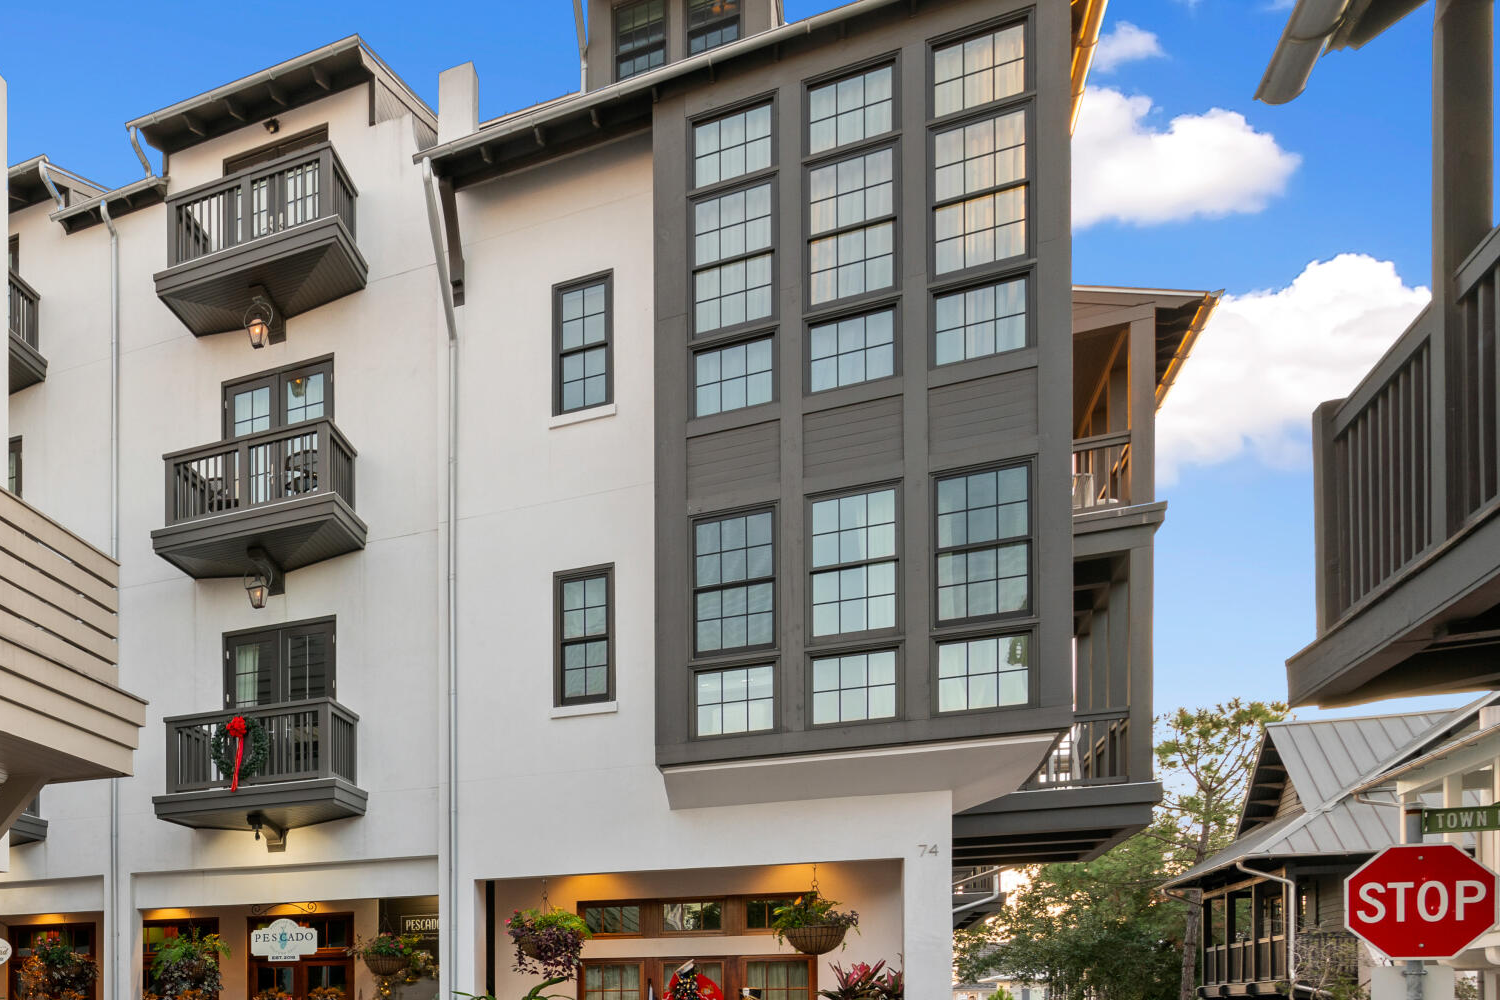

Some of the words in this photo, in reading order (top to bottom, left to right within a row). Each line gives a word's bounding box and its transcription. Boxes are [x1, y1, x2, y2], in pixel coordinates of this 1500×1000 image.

[1436, 811, 1487, 828] TOWN
[917, 844, 939, 857] 74
[1356, 880, 1487, 924] STOP
[255, 932, 314, 942] PESCADO
